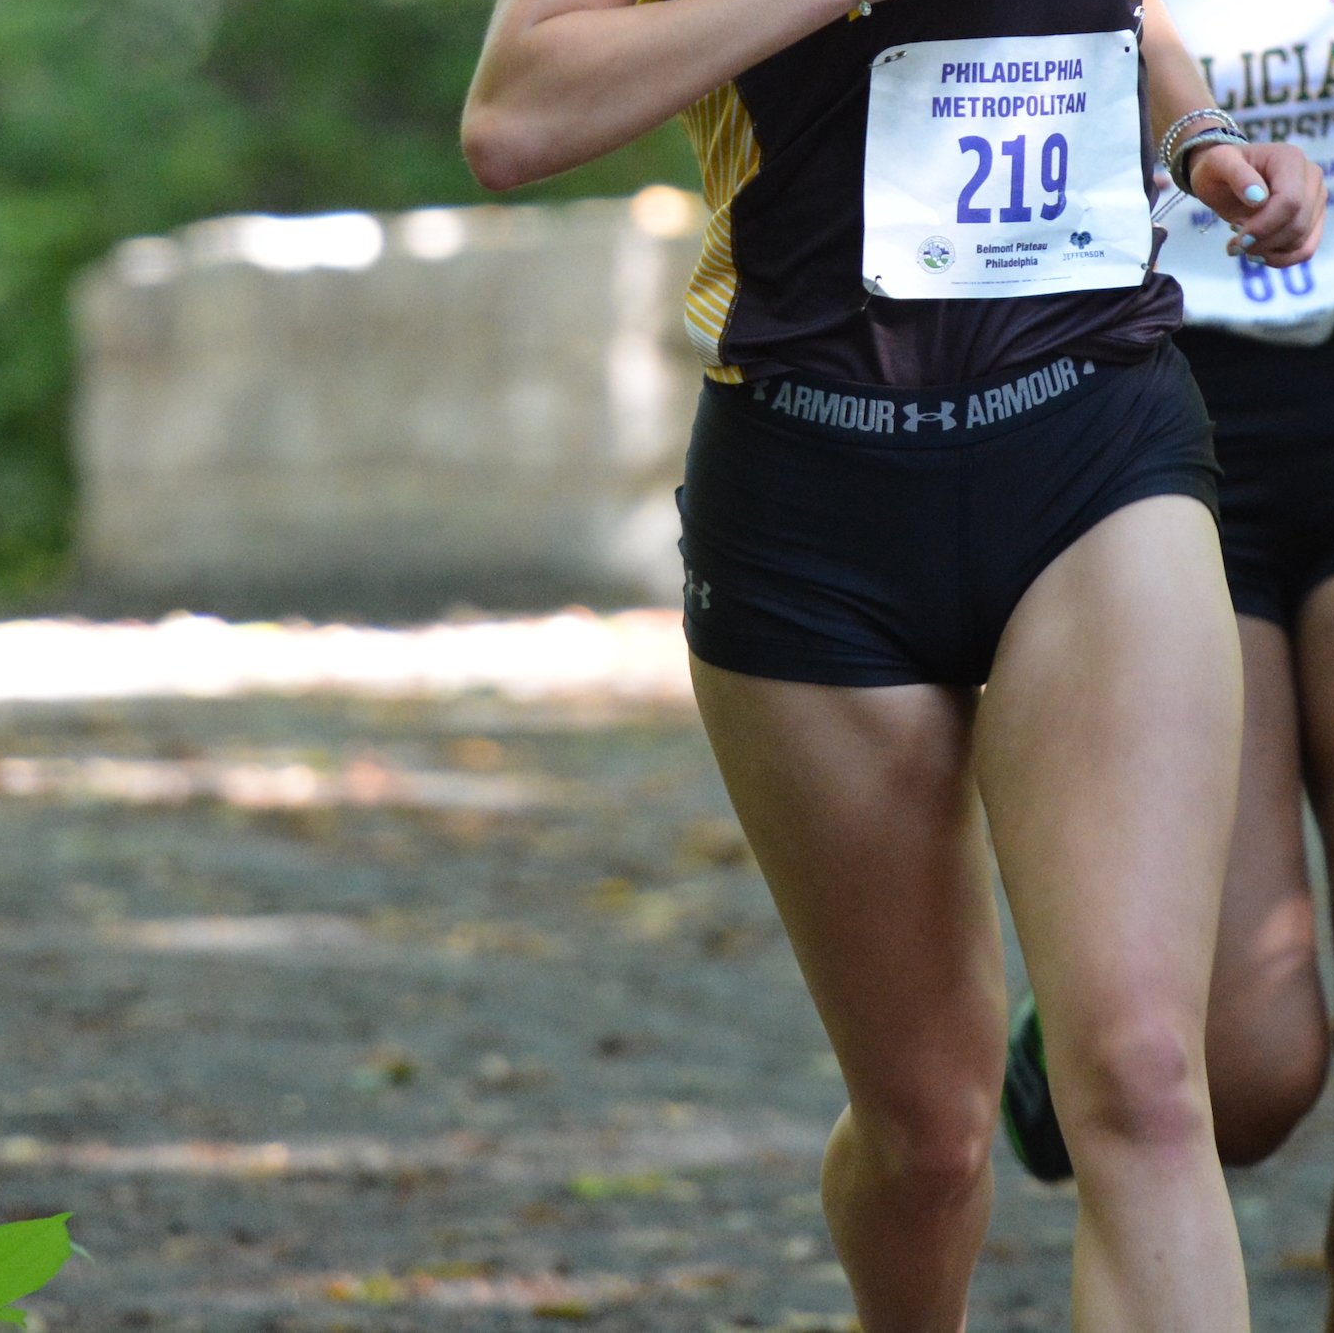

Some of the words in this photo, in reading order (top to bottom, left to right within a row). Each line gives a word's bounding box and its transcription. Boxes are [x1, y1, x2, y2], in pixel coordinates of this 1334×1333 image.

[941, 59, 1083, 84] PHILADELPHIA
[932, 92, 1086, 118] METROPOLITAN
[956, 132, 1068, 224] 219
[976, 243, 1014, 254] Belmont
[1016, 241, 1048, 253] Plateau
[985, 256, 1039, 269] Philadelphia
[966, 355, 1080, 430] ARMOUR
[772, 380, 895, 434] ARMOUR
